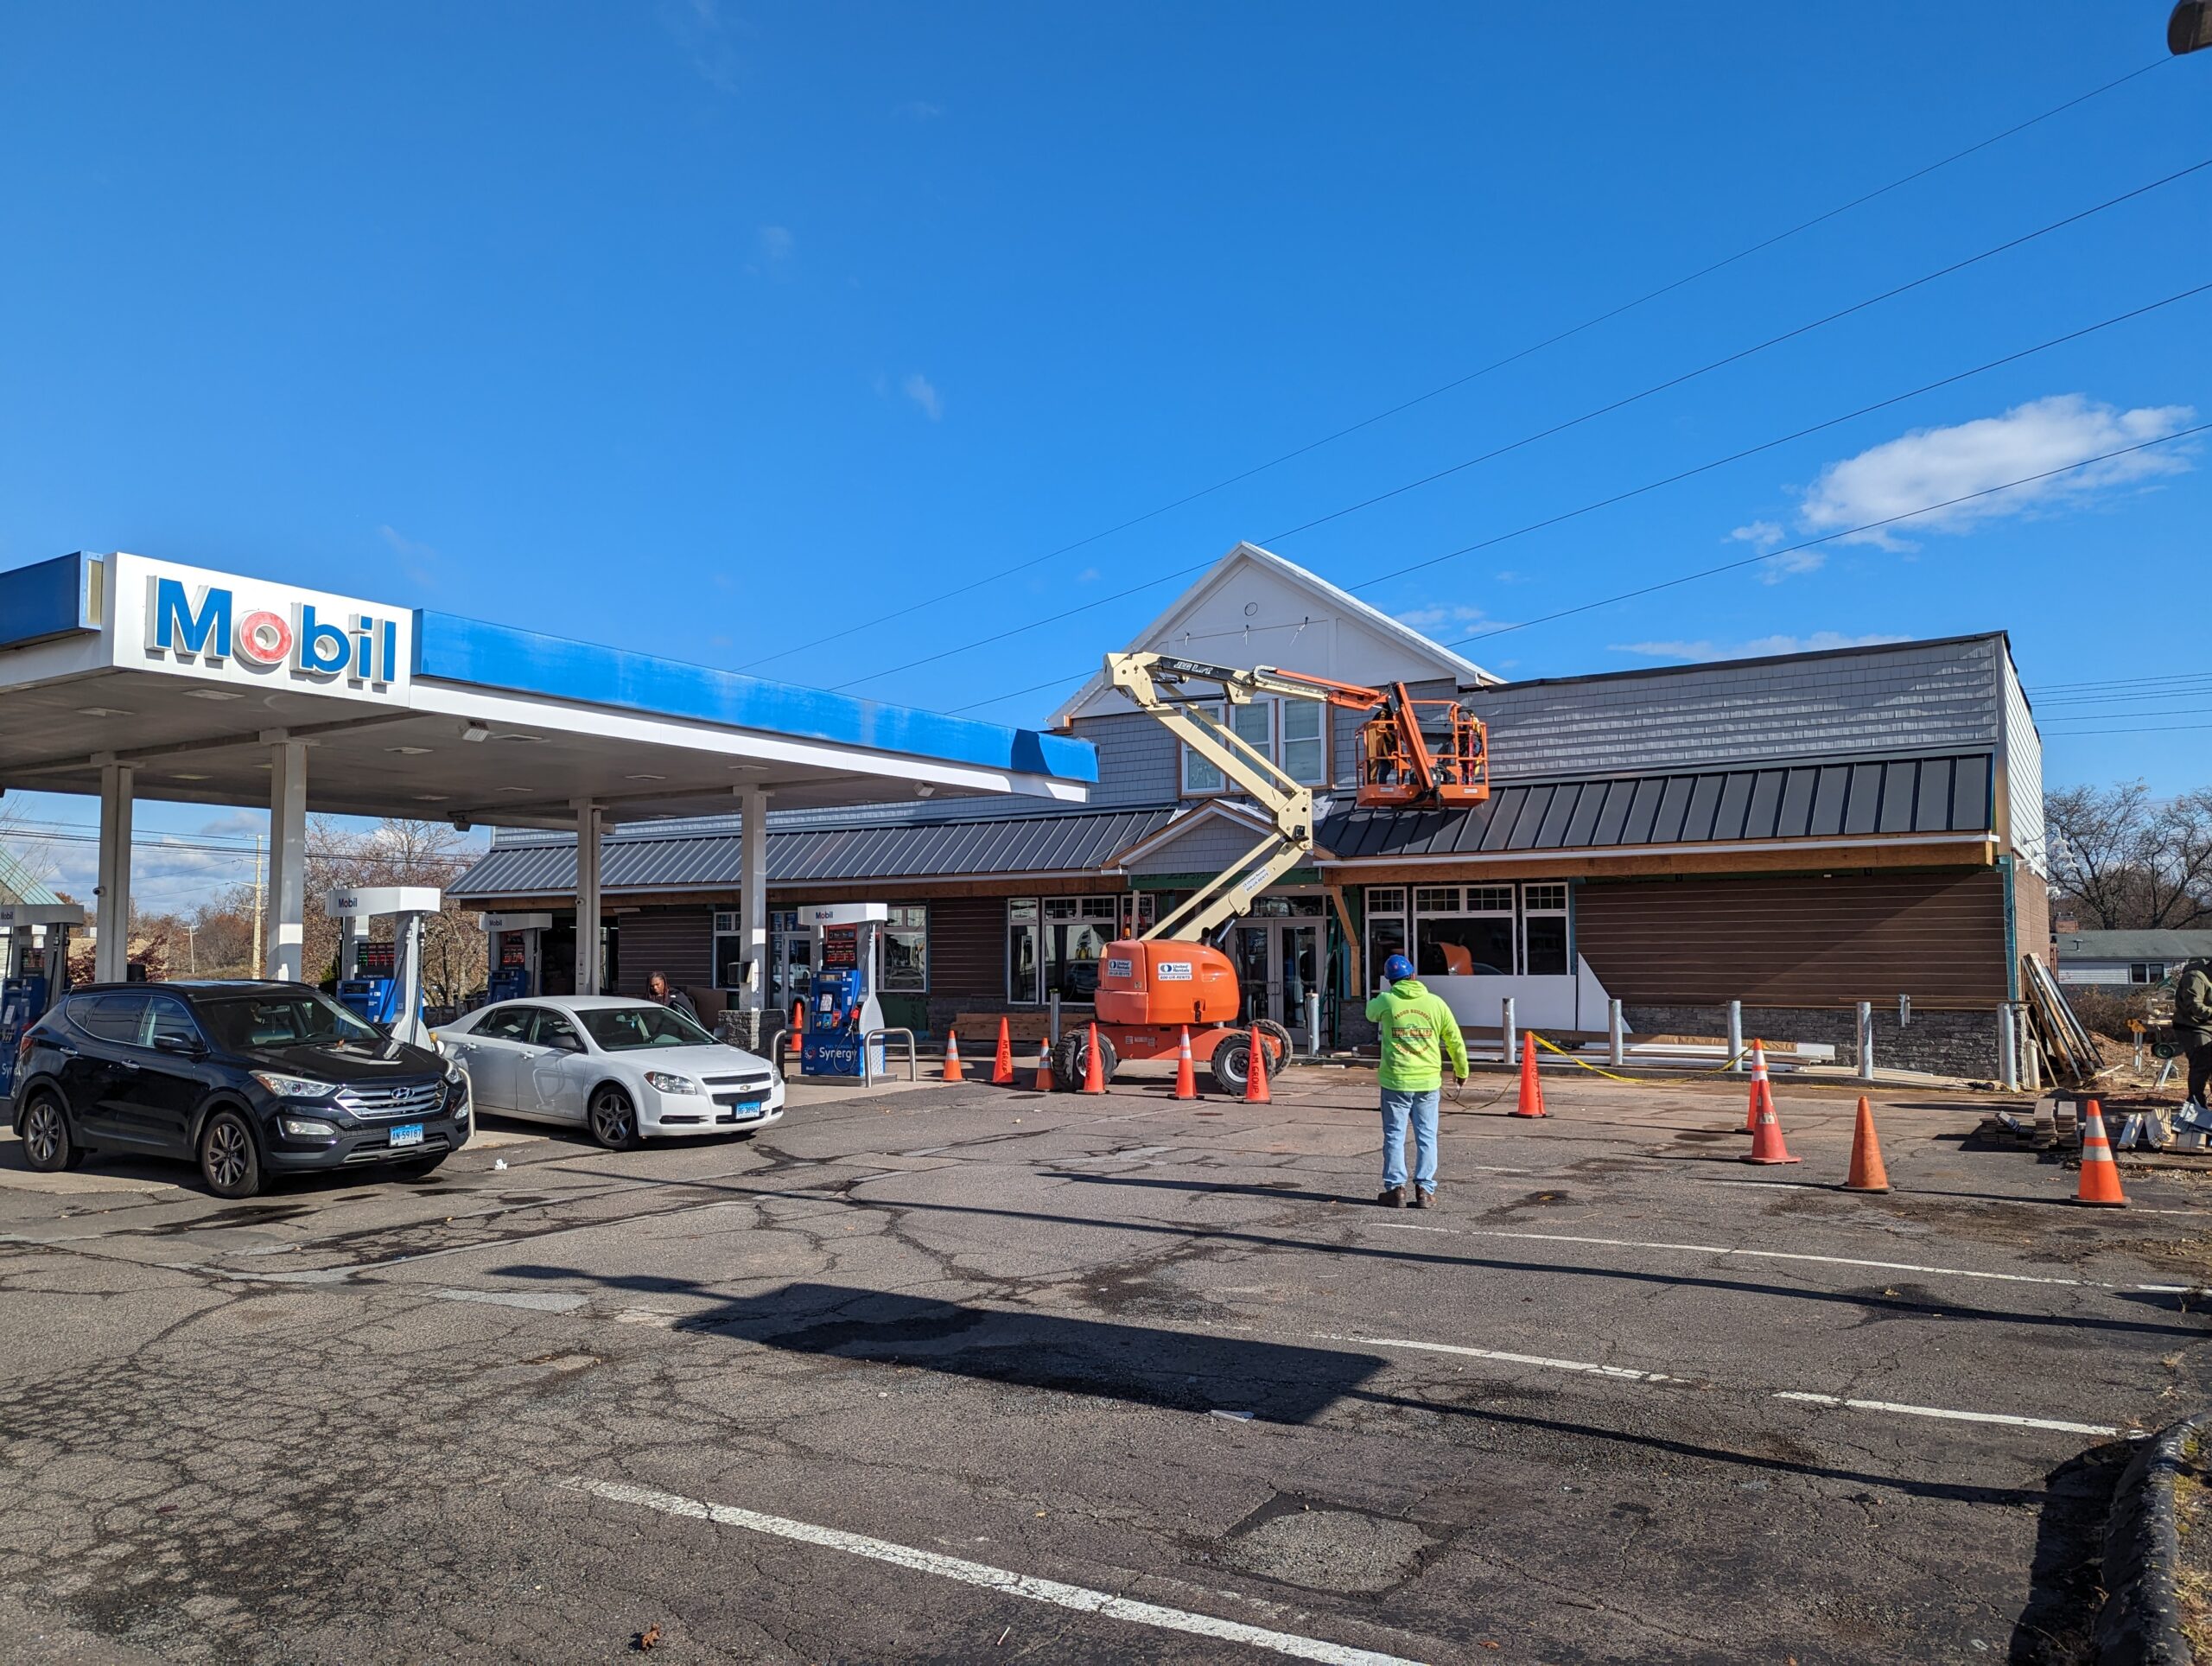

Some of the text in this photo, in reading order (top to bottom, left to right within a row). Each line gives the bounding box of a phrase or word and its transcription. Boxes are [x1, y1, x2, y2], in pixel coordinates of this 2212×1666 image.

[152, 577, 397, 684] Mobil
[338, 898, 358, 908] Mobil
[815, 911, 834, 919] Mobil
[1002, 1040, 1008, 1049] AM
[819, 1046, 858, 1062] Synergy
[1251, 1052, 1260, 1094] AM GROUP
